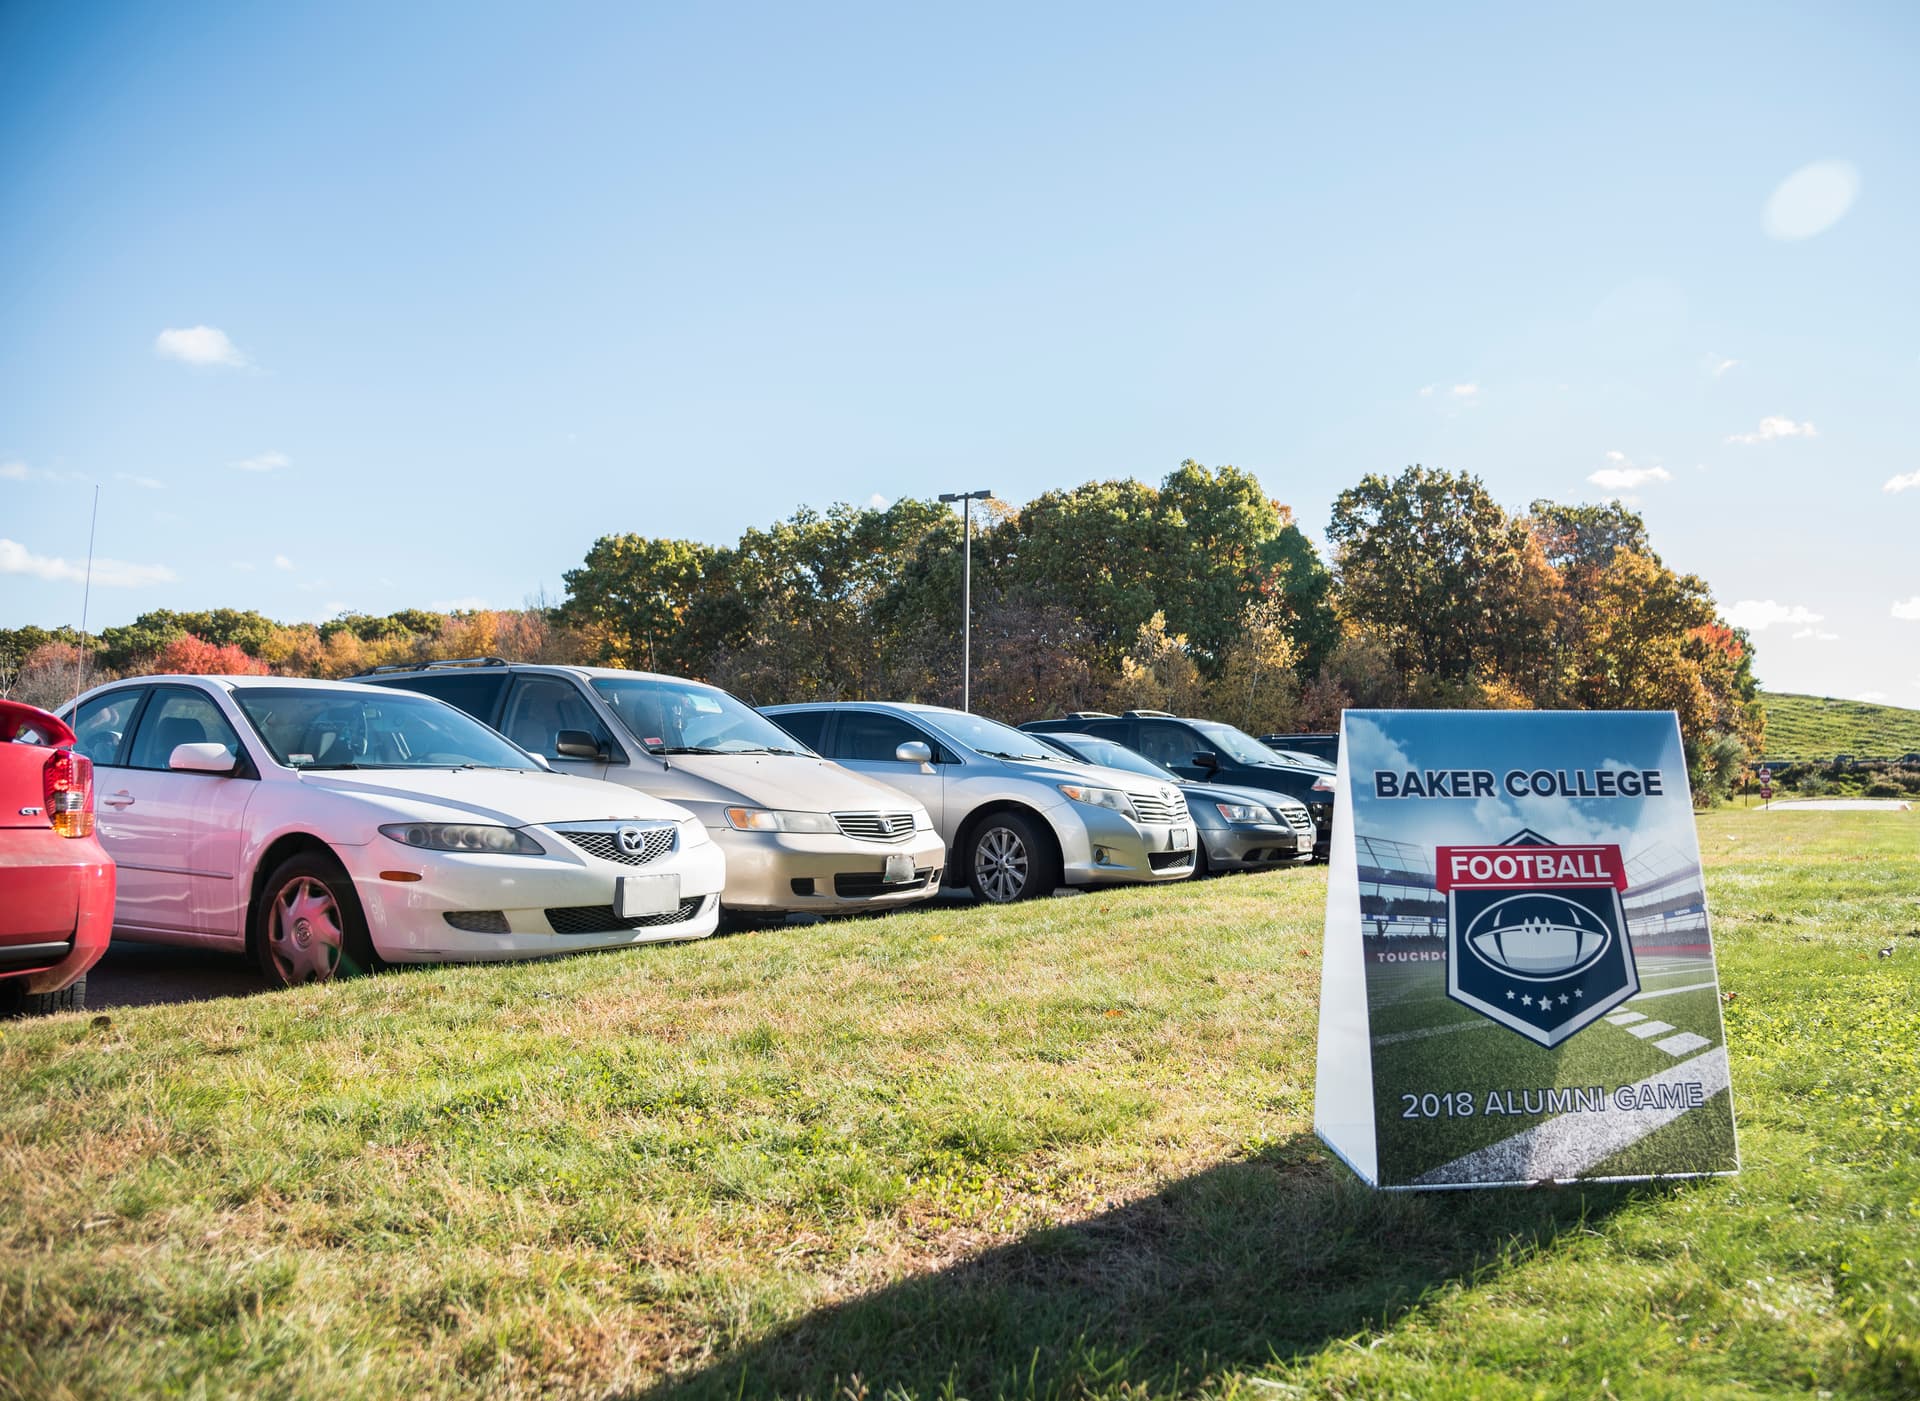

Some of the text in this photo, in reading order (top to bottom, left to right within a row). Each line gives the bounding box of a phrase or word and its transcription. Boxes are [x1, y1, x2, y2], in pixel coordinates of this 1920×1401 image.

[1374, 768, 1663, 799] BAKER COLLEGE
[1450, 854, 1612, 881] FOOTBALL
[1400, 1082, 1704, 1119] 2018 ALUMNI GAME
